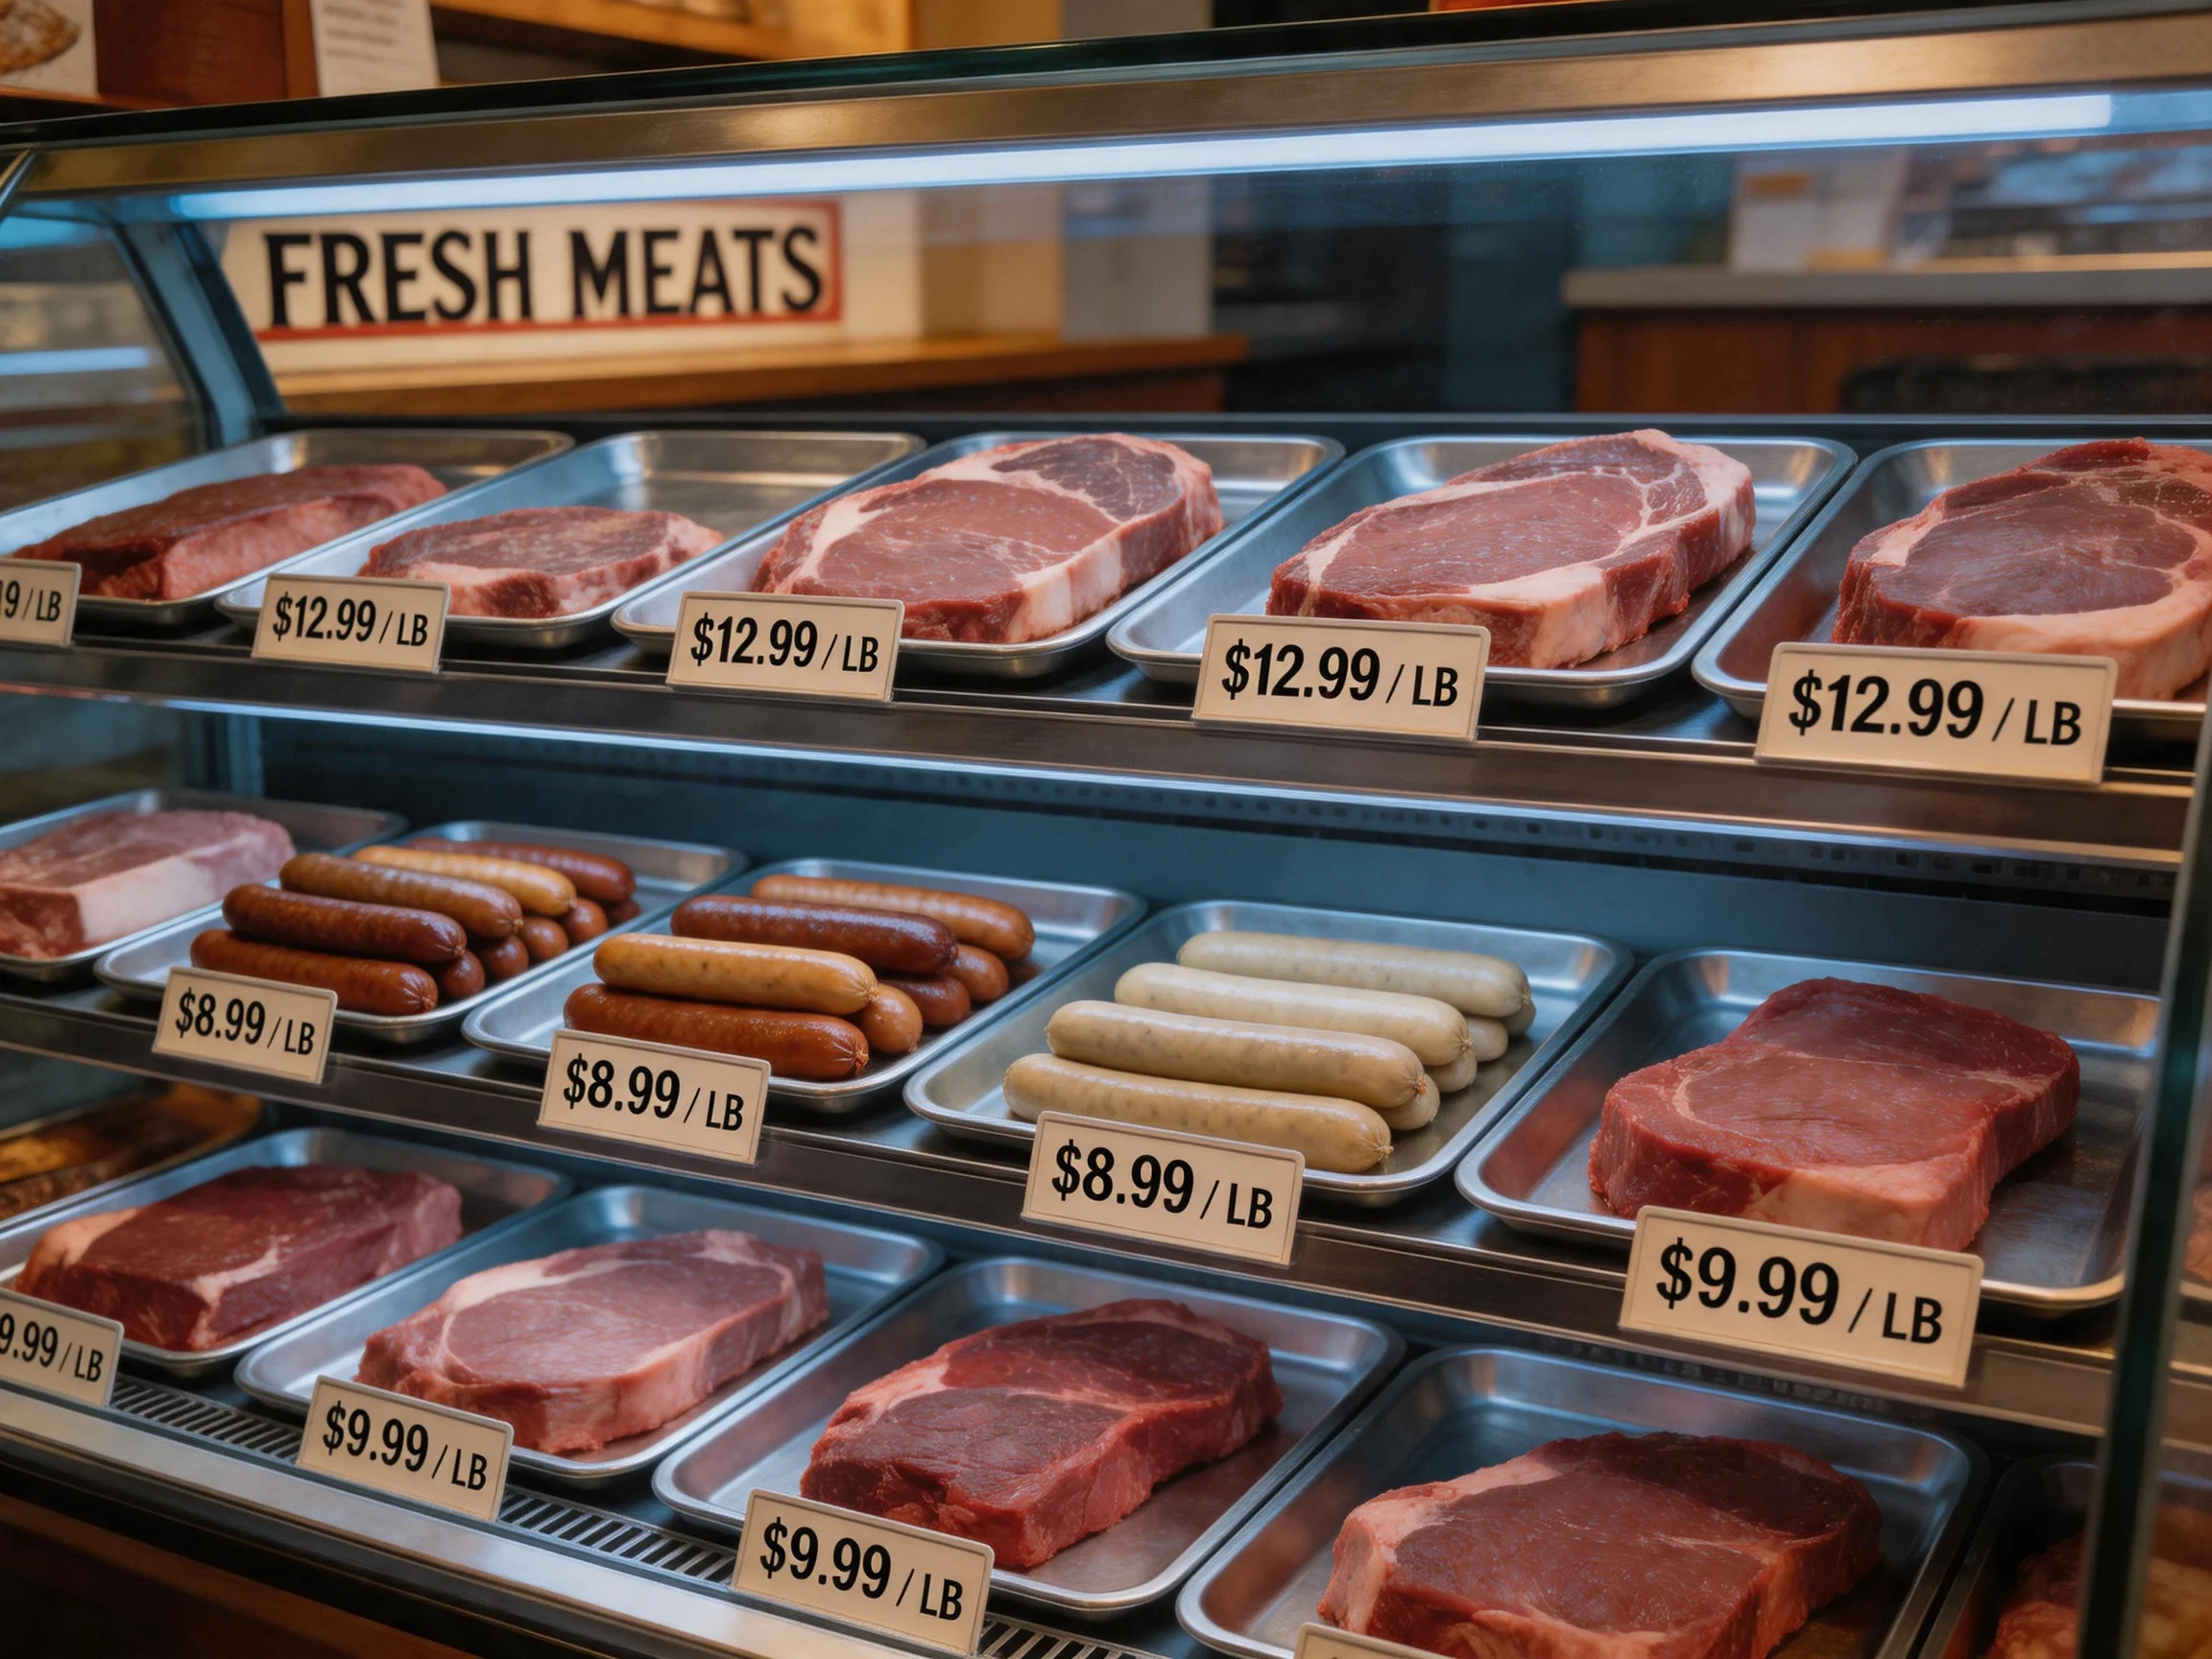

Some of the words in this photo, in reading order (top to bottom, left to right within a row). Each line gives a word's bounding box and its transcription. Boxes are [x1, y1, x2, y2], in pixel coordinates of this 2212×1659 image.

[263, 228, 534, 327] FRESH
[569, 226, 824, 320] MEATS
[272, 590, 375, 644] $12.99
[690, 613, 817, 668] $12.99
[1221, 637, 1380, 702] $12.99
[1788, 668, 1984, 739] $12.99
[176, 986, 265, 1046] $8.99
[563, 1052, 680, 1119] $8.99
[1052, 1140, 1194, 1214] $8.99
[1655, 1237, 1839, 1326] $9.99
[323, 1400, 428, 1473] $9.99
[760, 1516, 891, 1599] $9.99
